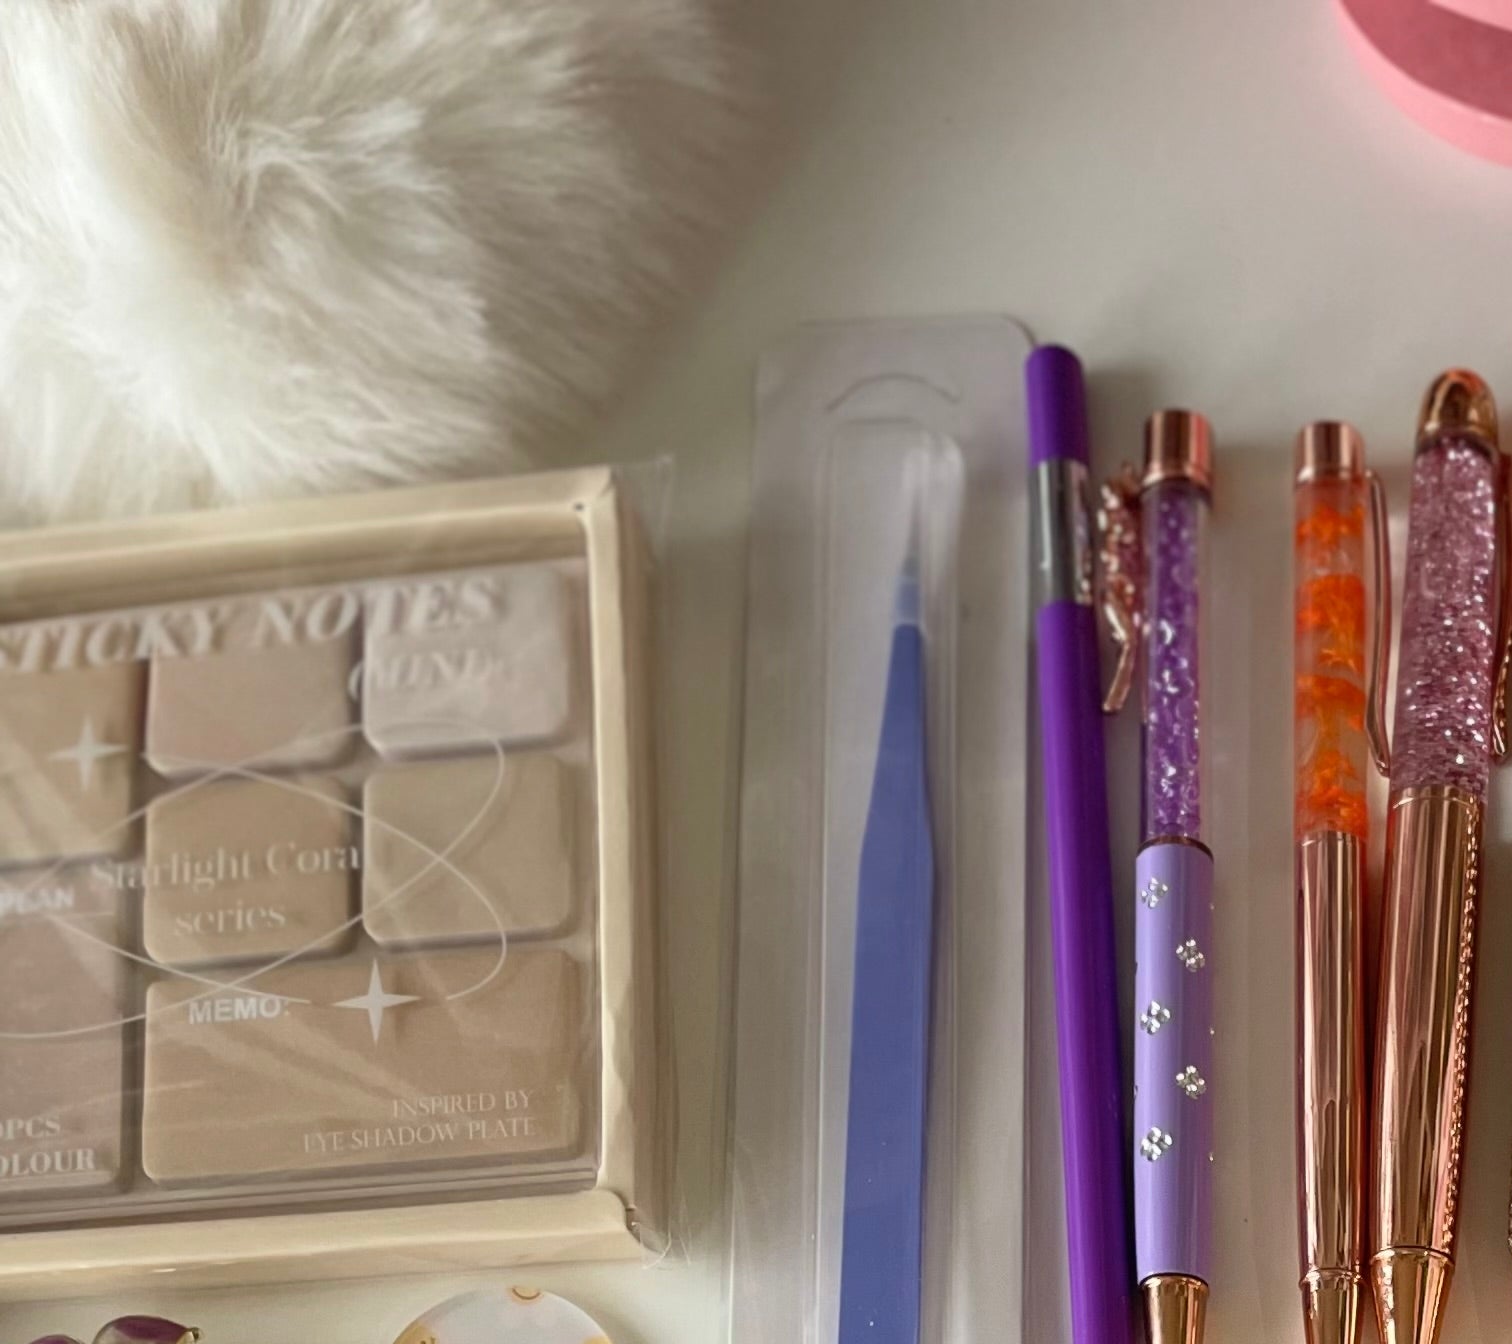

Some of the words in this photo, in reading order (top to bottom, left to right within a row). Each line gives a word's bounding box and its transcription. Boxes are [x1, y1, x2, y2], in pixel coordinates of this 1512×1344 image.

[0, 606, 233, 671] TICKY
[250, 576, 494, 648] NOTES
[174, 899, 288, 937] series
[188, 996, 292, 1024] MEMO:
[392, 1092, 496, 1118] INSPIRED
[504, 1088, 534, 1110] BY
[350, 1122, 458, 1149] SHADOW
[467, 1117, 537, 1141] PLATE
